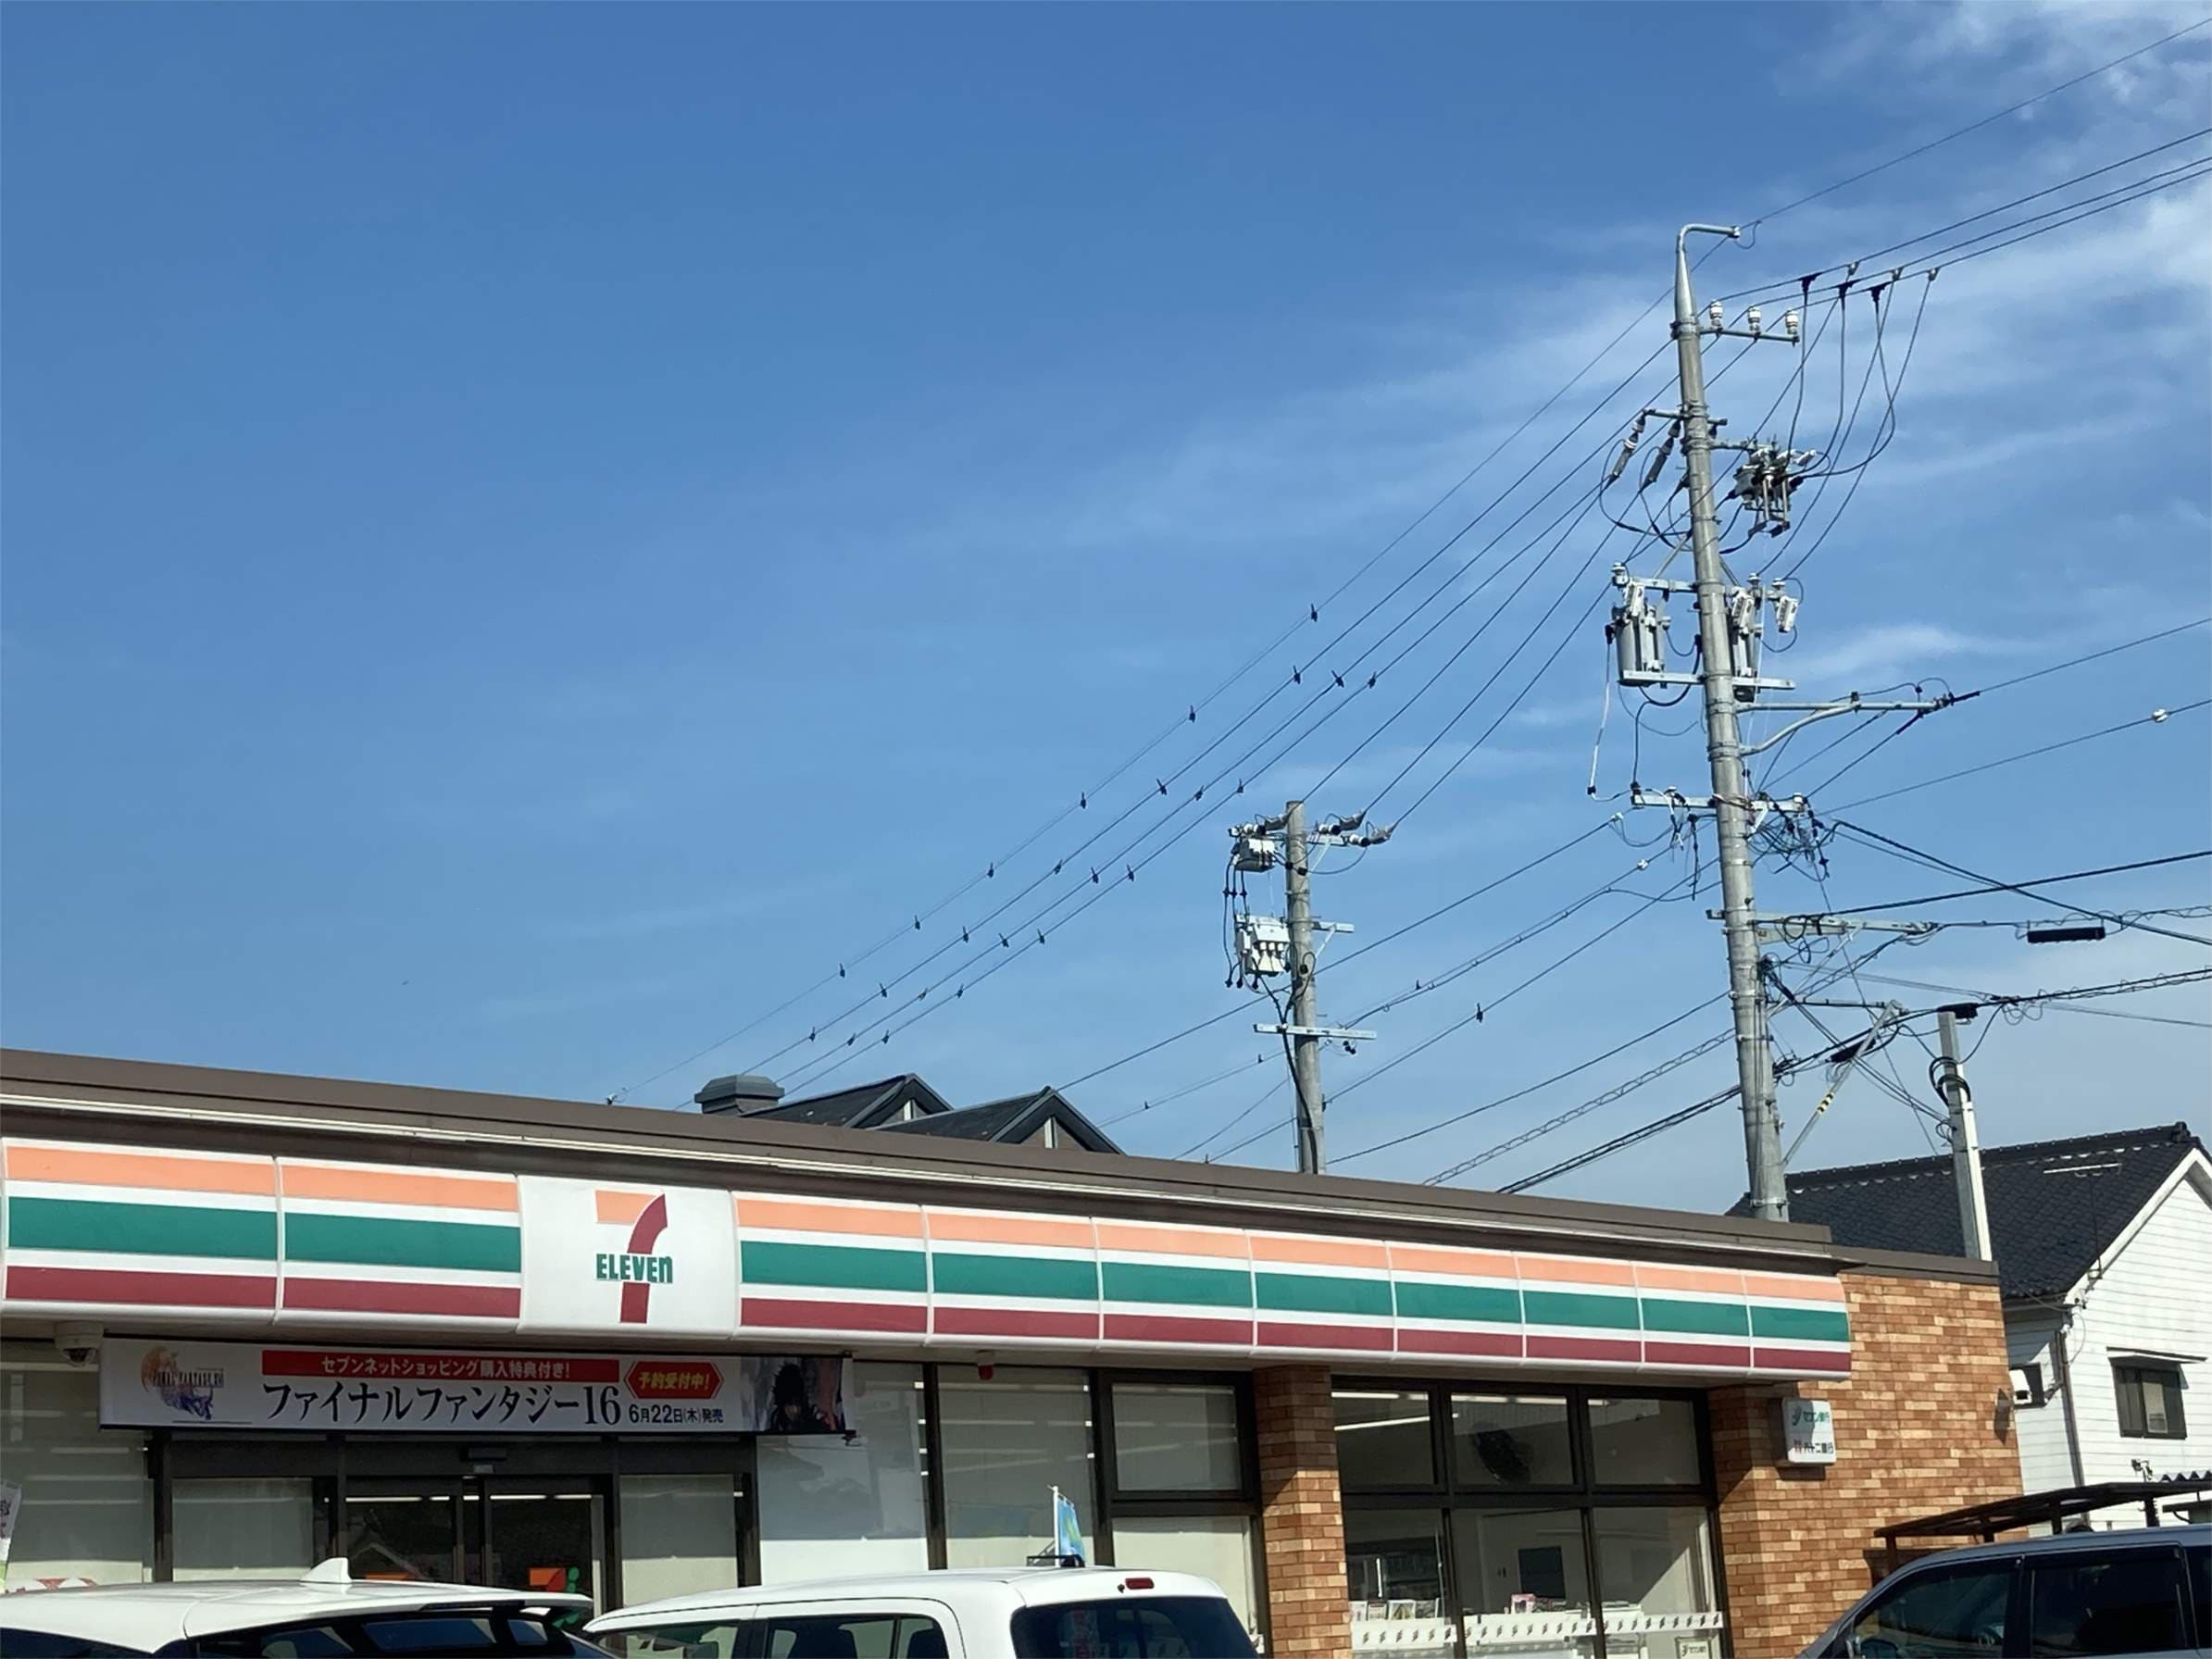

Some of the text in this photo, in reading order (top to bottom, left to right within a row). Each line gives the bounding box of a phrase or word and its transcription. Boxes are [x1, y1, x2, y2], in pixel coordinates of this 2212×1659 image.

[594, 1190, 669, 1324] 7
[263, 1380, 621, 1426] ファイナルファンタジー16
[638, 1371, 711, 1391] 予約受付中!
